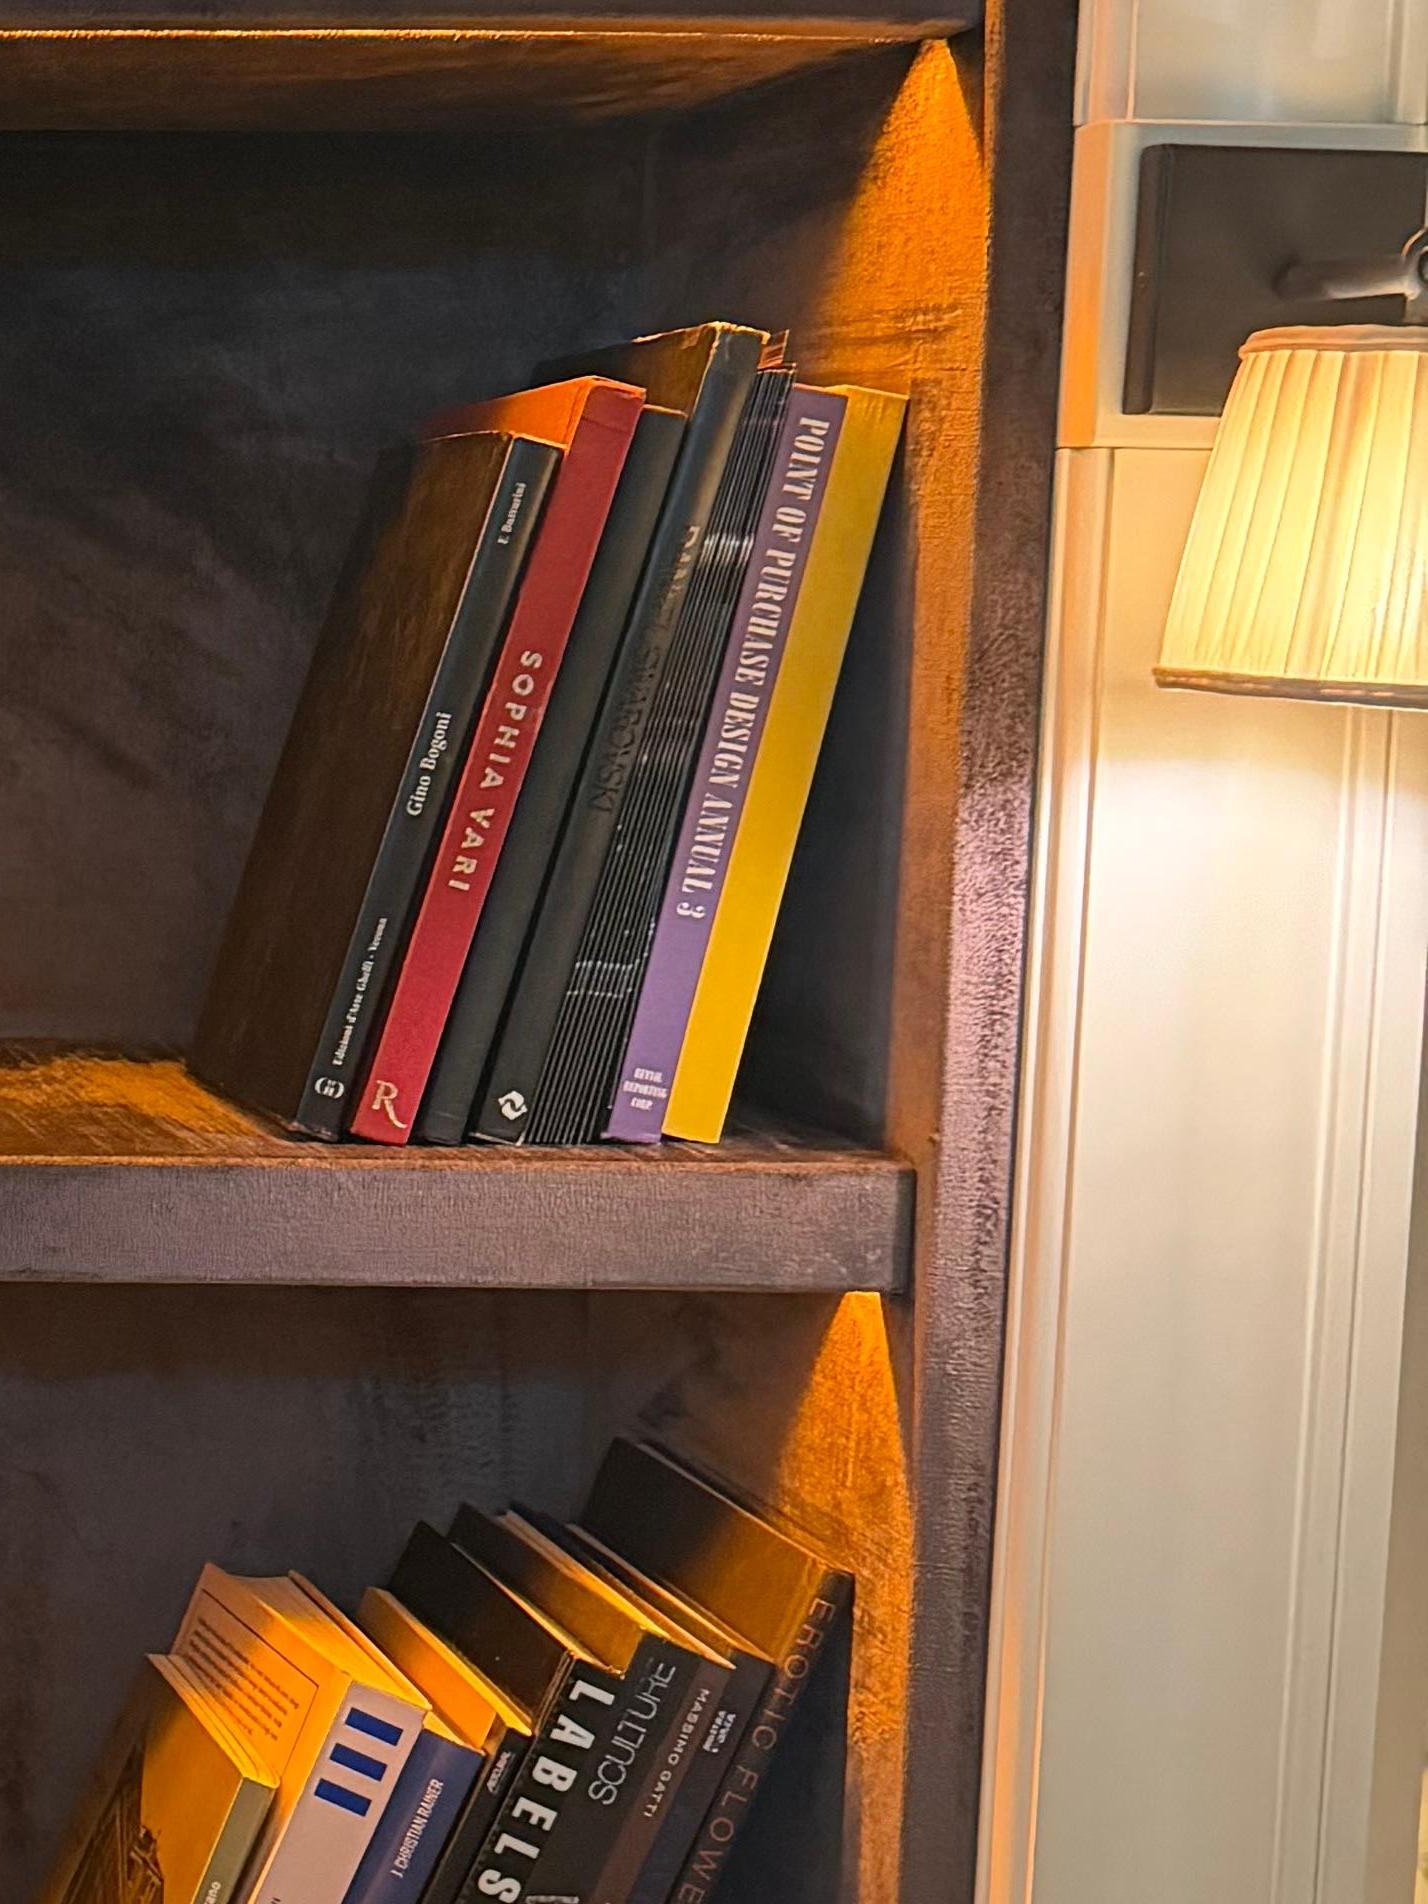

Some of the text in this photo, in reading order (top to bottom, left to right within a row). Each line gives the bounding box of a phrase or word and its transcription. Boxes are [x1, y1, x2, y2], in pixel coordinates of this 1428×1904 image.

[675, 415, 830, 921] POINT OF PURCHASE DESIGN ANNUAL 3
[406, 711, 453, 817] Gino Bogoni
[447, 649, 543, 892] SOPHIA VARI
[587, 1662, 676, 1806] SCULTURE
[751, 1596, 837, 1751] EROTIC
[394, 1777, 445, 1871] CHRISTIAN RAINER
[478, 1679, 616, 1904] LABELS
[643, 1688, 710, 1818] MASSIMO GATTI
